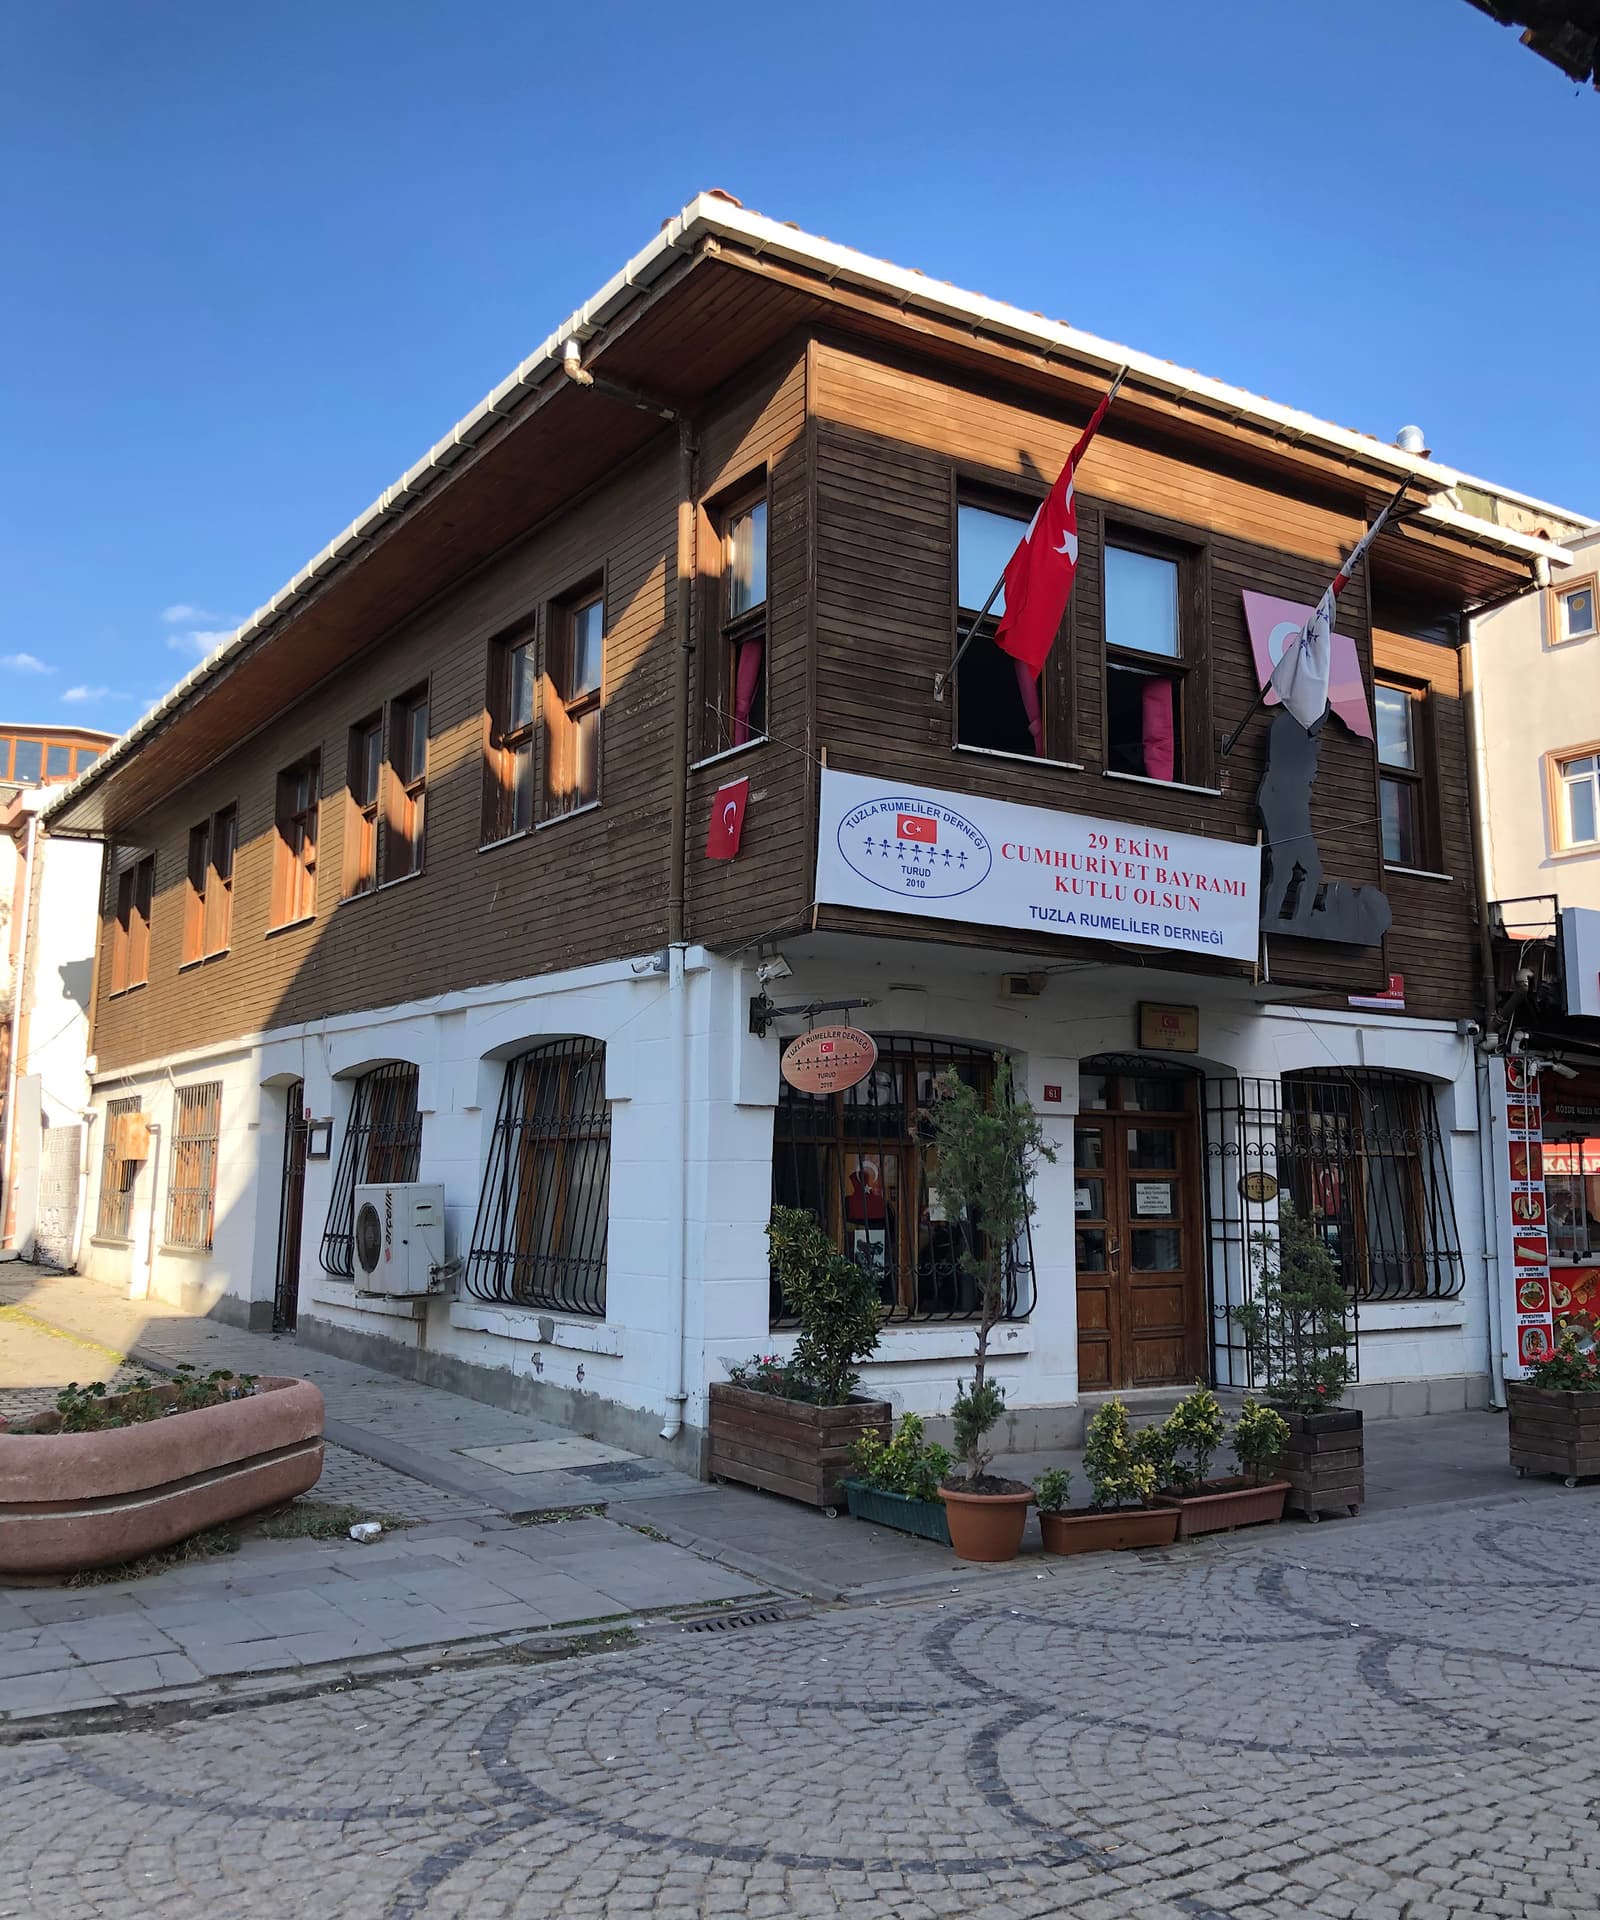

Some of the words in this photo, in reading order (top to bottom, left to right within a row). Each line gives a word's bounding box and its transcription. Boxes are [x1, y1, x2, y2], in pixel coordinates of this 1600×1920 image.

[845, 805, 879, 829] TUZLA
[880, 801, 941, 819] RUMELİLER
[943, 812, 987, 851] DERNEĞİ
[1088, 833, 1109, 850] 29
[1115, 837, 1169, 861] EKİM
[901, 864, 932, 878] TURUD
[905, 878, 926, 889] 2010
[1001, 842, 1150, 881] CUMHURİYET
[1156, 867, 1247, 897] BAYRAMI
[1055, 875, 1127, 902] KUTLU
[1133, 887, 1201, 913] OLSUN
[1029, 905, 1076, 925] TUZLA
[1080, 912, 1160, 937] RUMELİLER
[1164, 924, 1223, 945] DERNEĞİ
[787, 1040, 806, 1060] TUZLA
[805, 1031, 842, 1045] RUMELİLER
